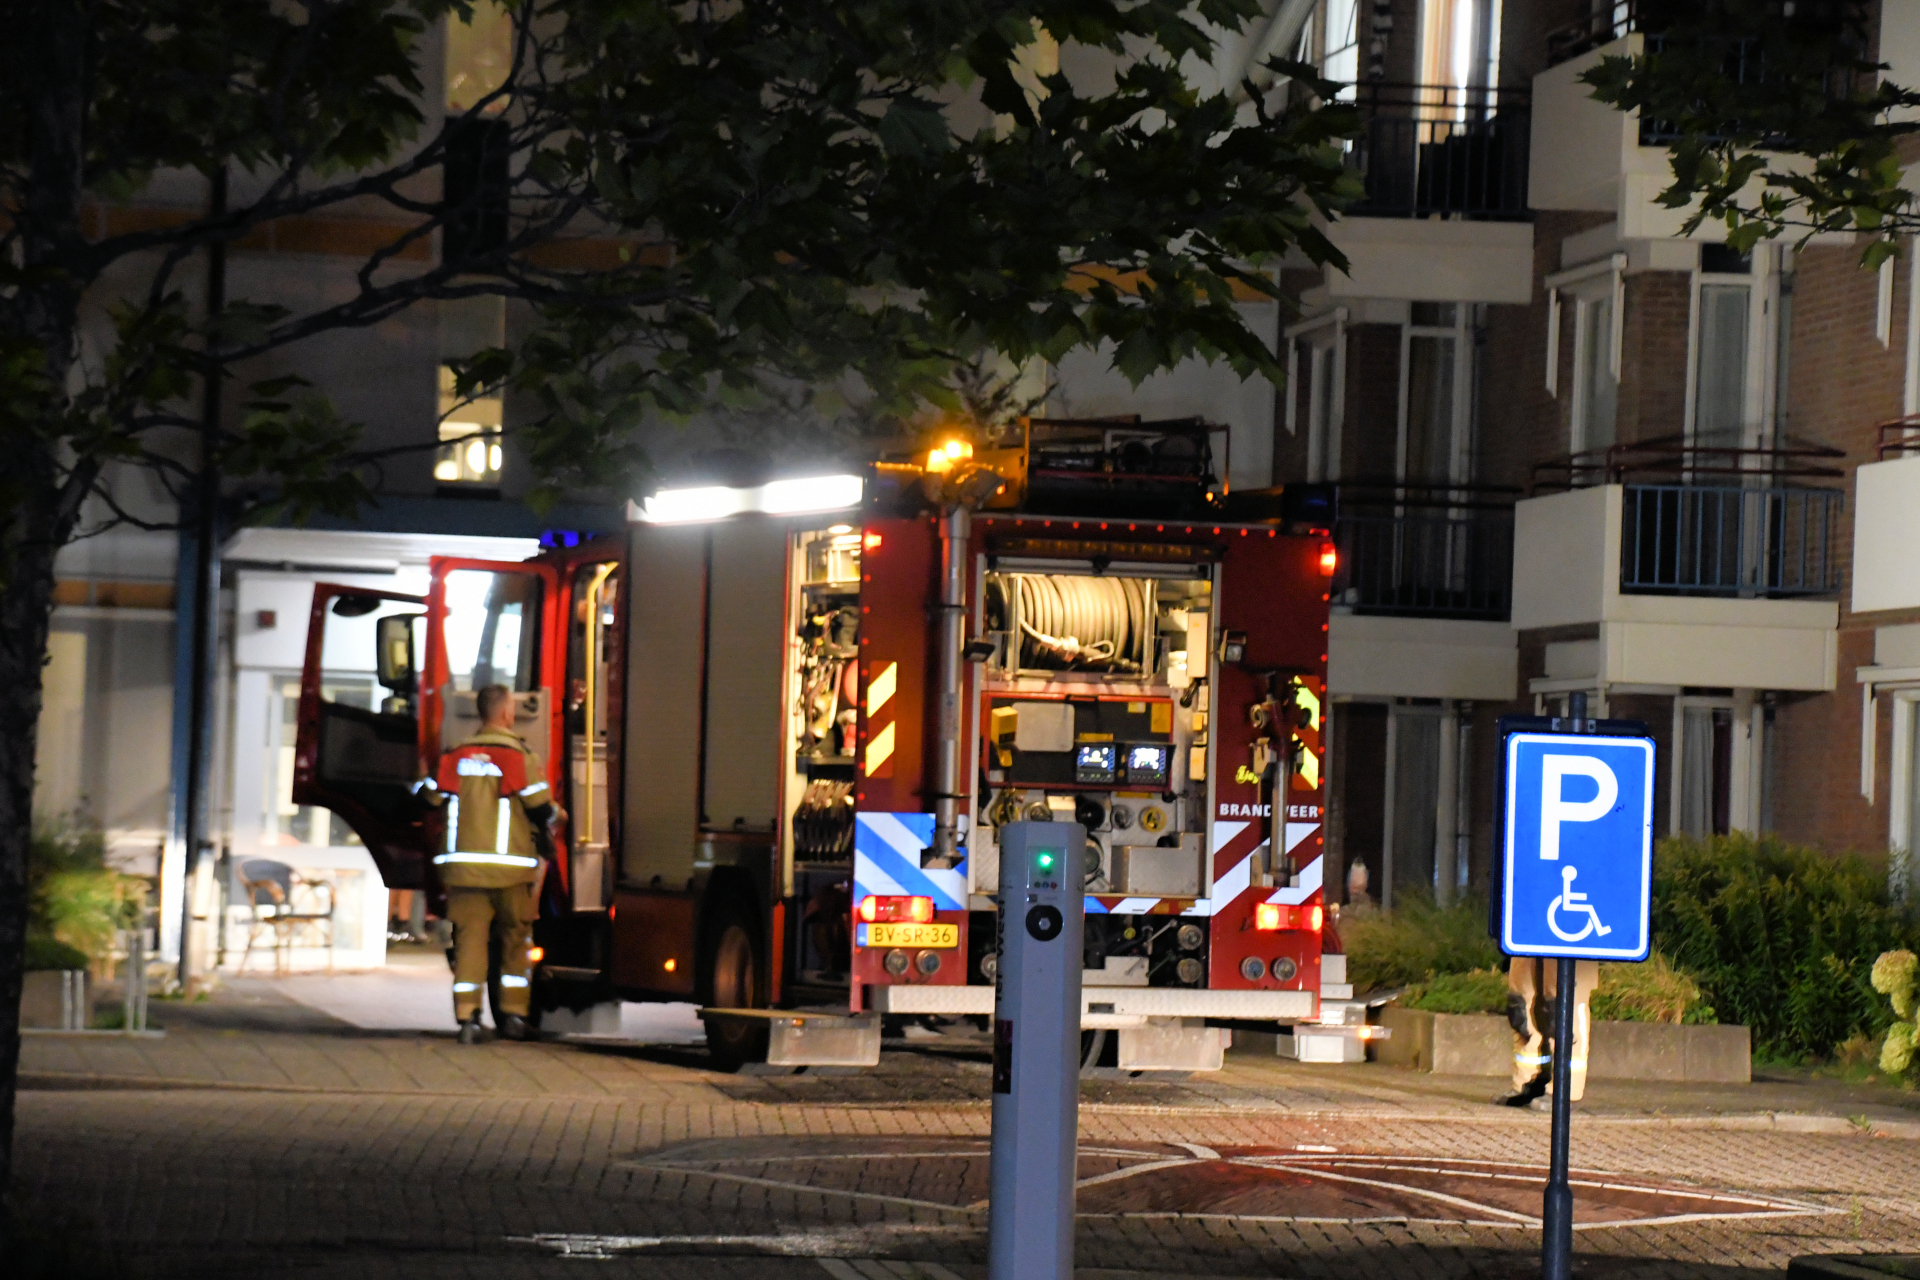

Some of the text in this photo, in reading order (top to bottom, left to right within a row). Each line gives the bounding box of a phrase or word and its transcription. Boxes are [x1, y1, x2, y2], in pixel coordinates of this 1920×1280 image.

[1219, 803, 1318, 818] BRANDEER
[1540, 754, 1618, 860] P
[874, 927, 951, 943] BV-SR-36
